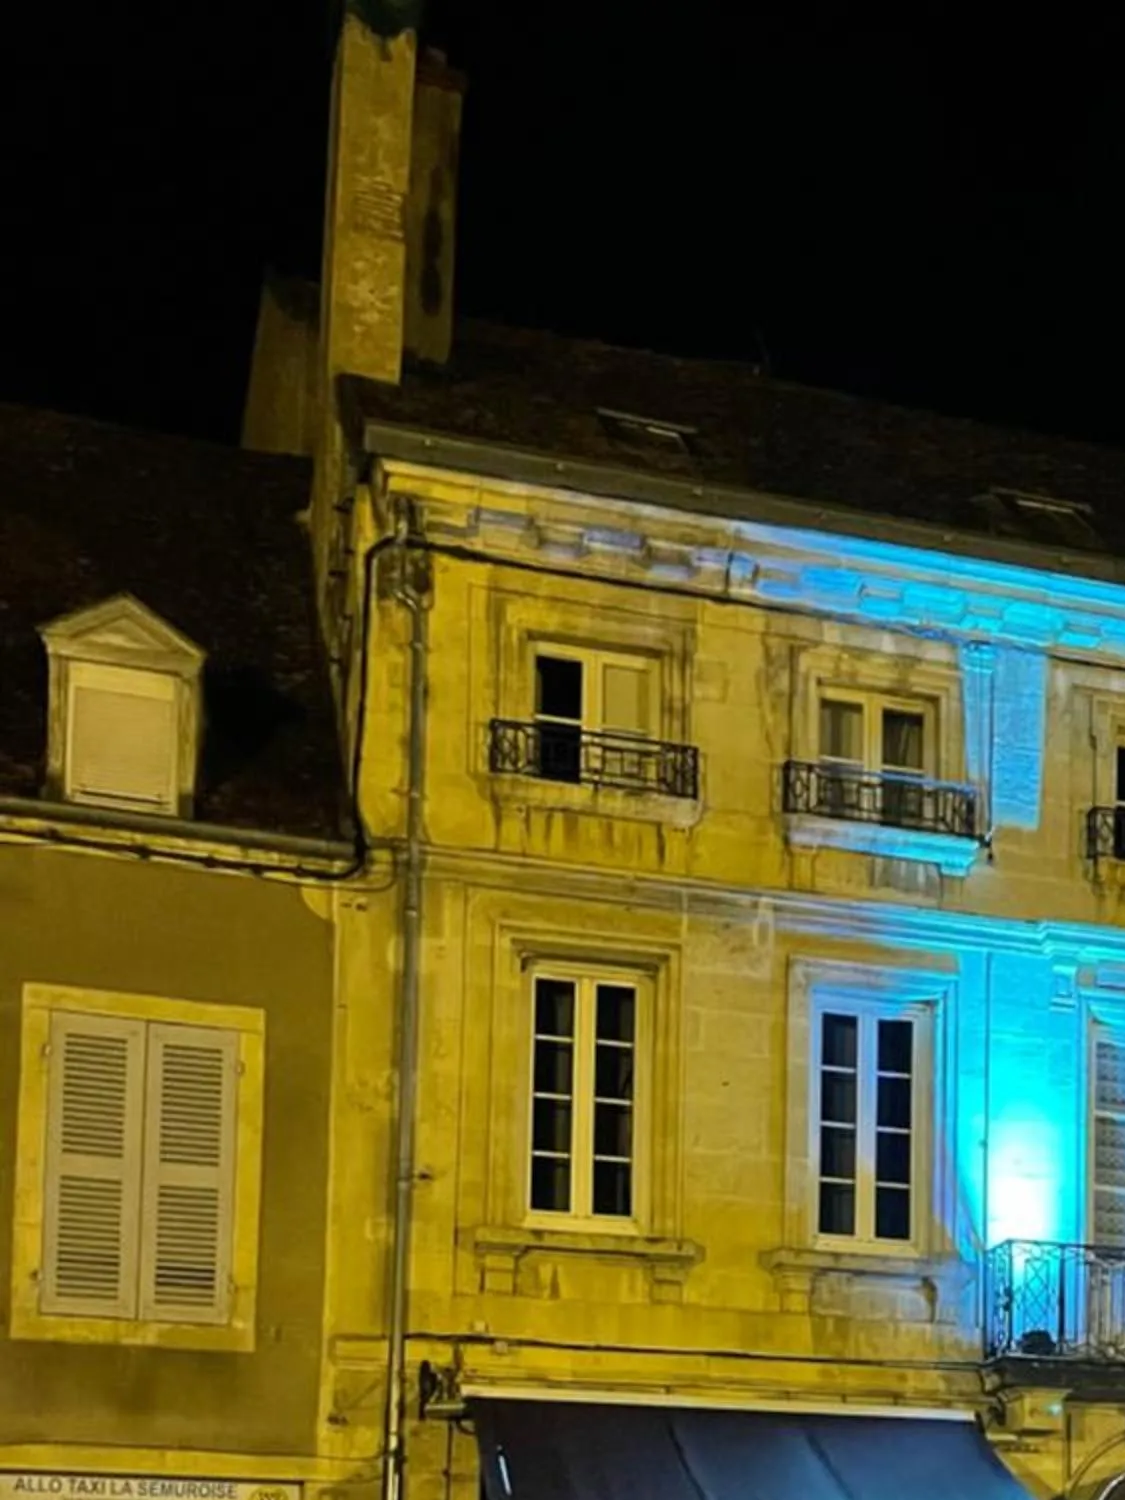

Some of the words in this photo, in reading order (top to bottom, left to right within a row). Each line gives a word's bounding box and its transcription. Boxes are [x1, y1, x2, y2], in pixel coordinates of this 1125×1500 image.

[14, 1477, 62, 1493] ALLO
[69, 1478, 106, 1495] TAXI
[110, 1480, 133, 1495] LA
[137, 1480, 238, 1499] SEMUROISE
